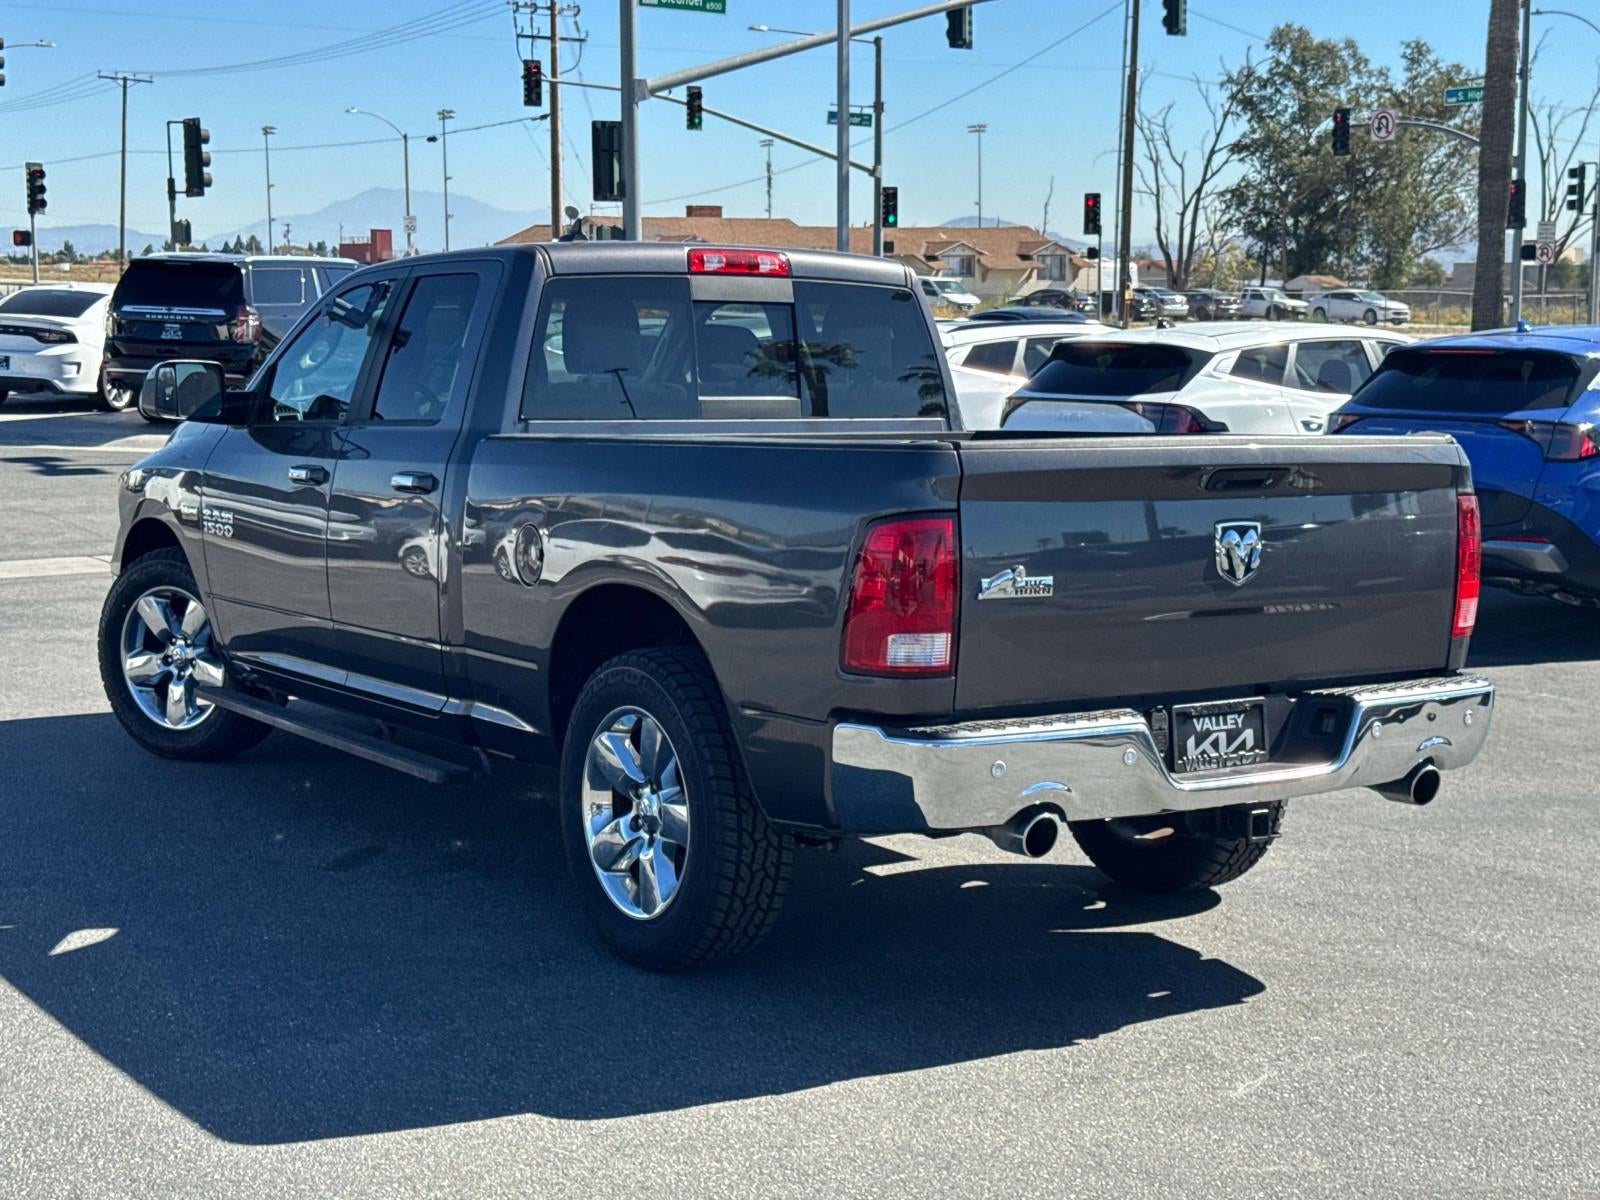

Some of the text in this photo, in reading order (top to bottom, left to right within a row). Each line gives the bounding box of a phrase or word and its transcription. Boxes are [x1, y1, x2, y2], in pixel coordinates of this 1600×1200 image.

[203, 521, 234, 538] 1500
[1015, 587, 1051, 596] HORN
[1192, 714, 1245, 732] VALLEY
[1186, 728, 1254, 757] KIA
